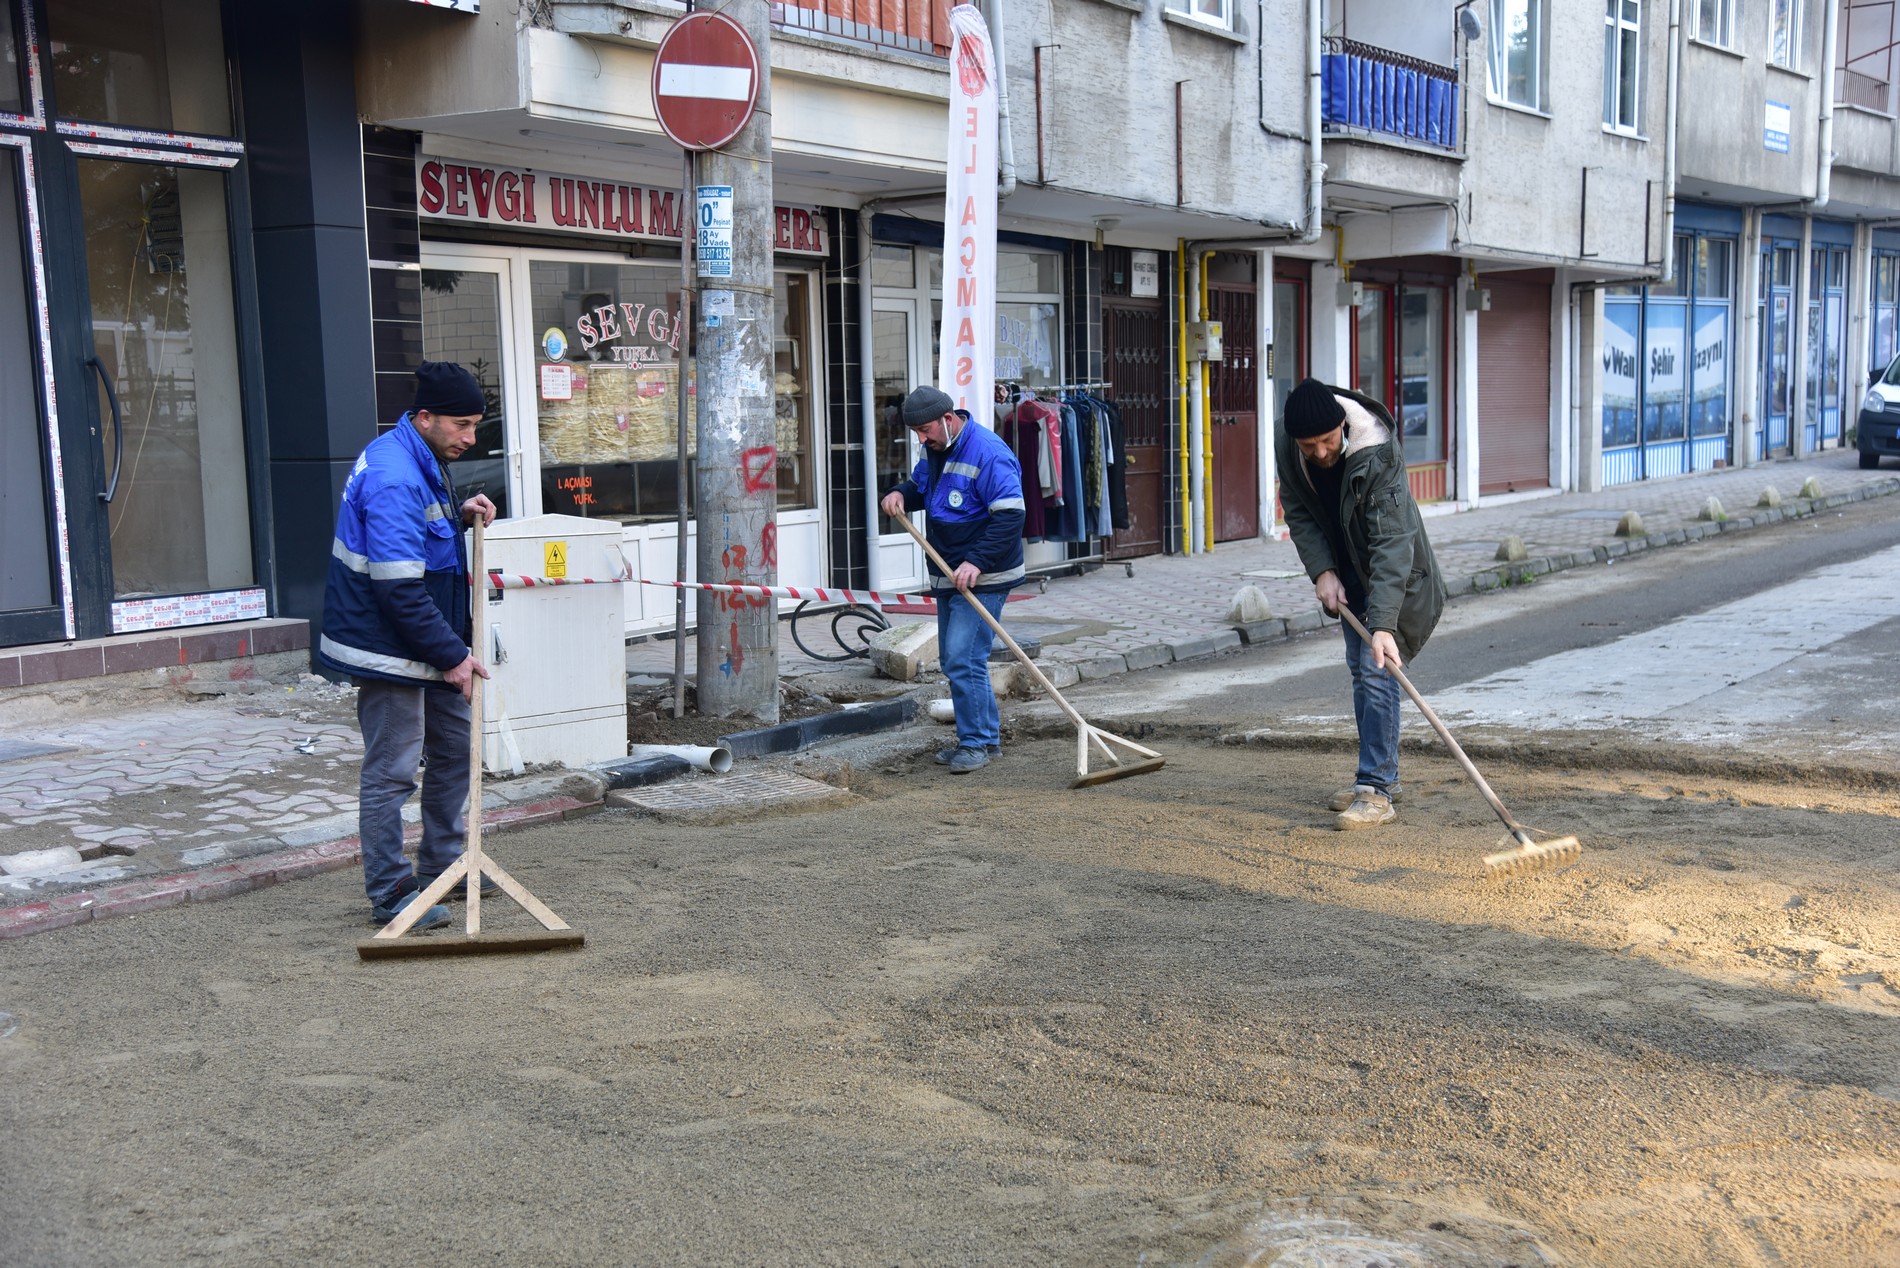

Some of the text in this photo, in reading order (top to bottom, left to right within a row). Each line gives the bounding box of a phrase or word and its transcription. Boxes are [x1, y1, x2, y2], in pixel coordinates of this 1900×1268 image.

[419, 160, 537, 223] SEVGİ
[549, 176, 644, 235] UNLU
[713, 218, 731, 226] Peşinat
[709, 230, 719, 238] Ay
[709, 239, 729, 247] Vade
[723, 248, 730, 259] 84
[577, 302, 681, 351] SEVGİ
[610, 346, 660, 362] YUFKA
[1611, 346, 1635, 379] Wall
[1651, 347, 1675, 384] Şehir
[564, 475, 592, 492] AÇMASI
[573, 493, 598, 506] YUFK
